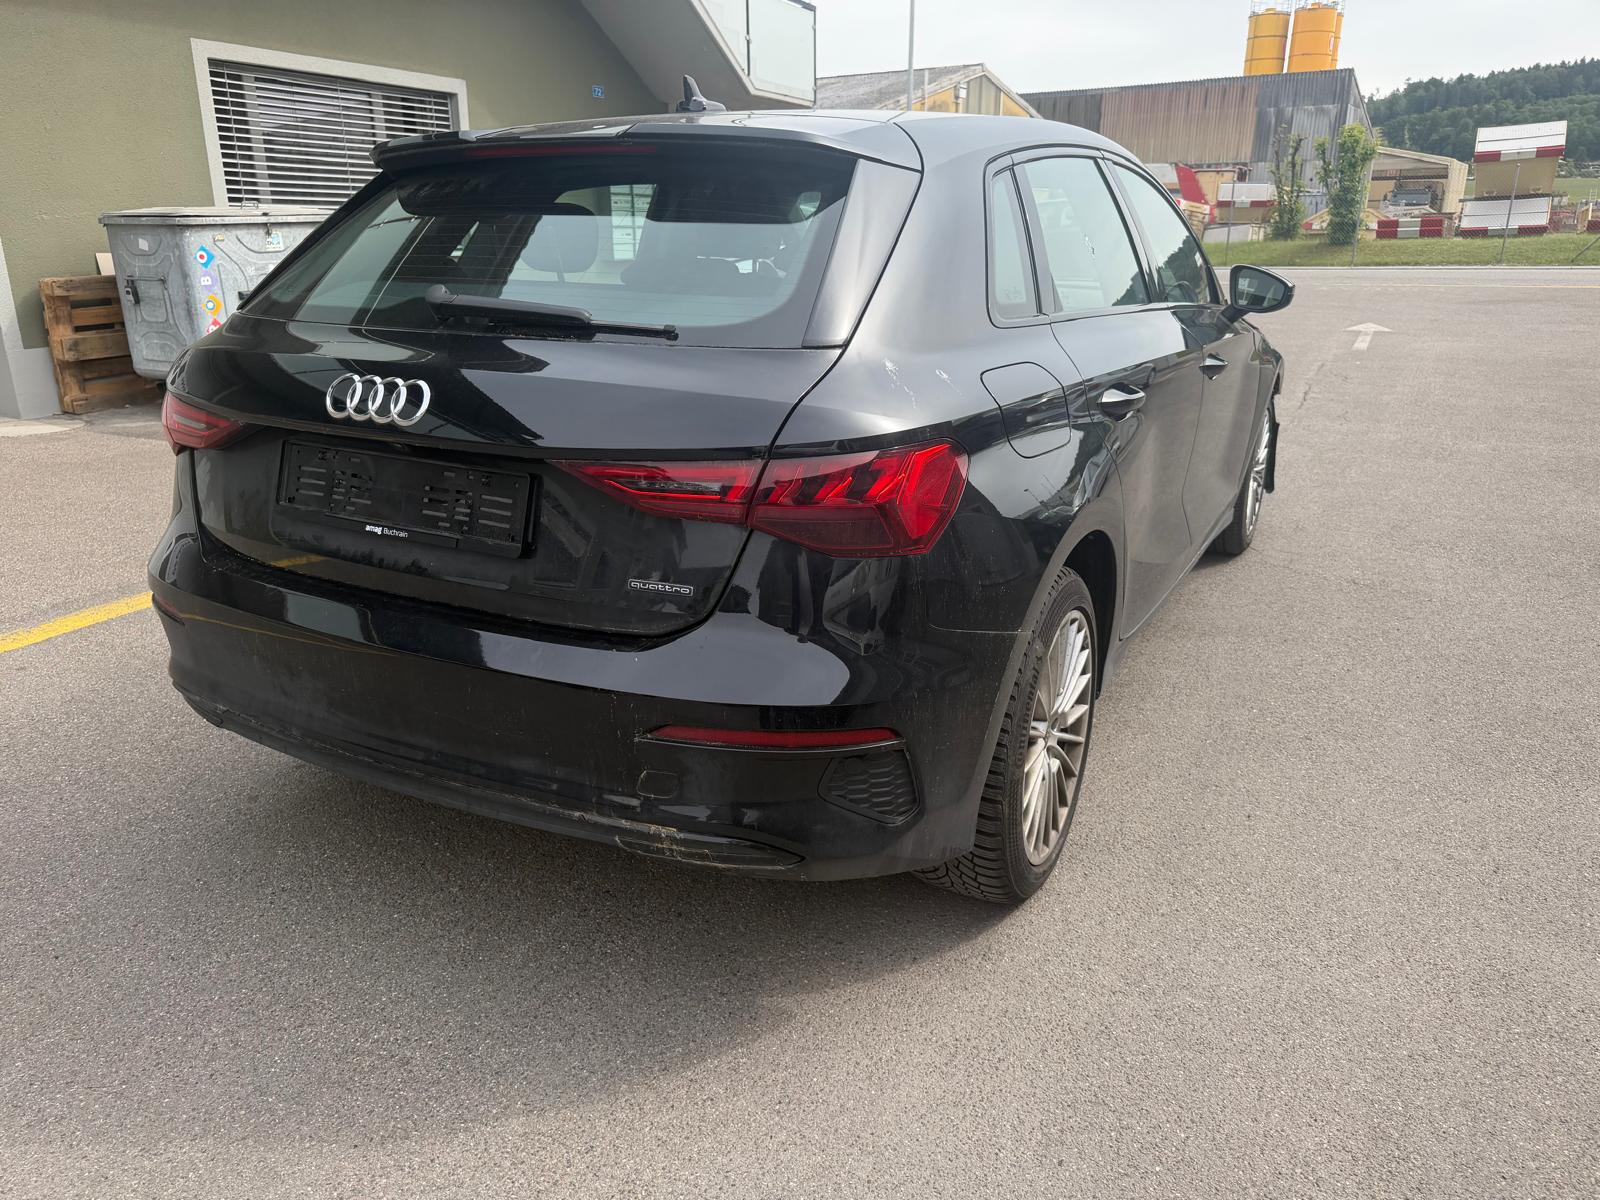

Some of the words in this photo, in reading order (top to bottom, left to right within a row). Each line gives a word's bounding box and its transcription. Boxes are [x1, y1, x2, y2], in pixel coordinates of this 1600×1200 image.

[365, 524, 382, 535] amag
[383, 527, 409, 538] Buchrain
[630, 581, 690, 594] quattro
